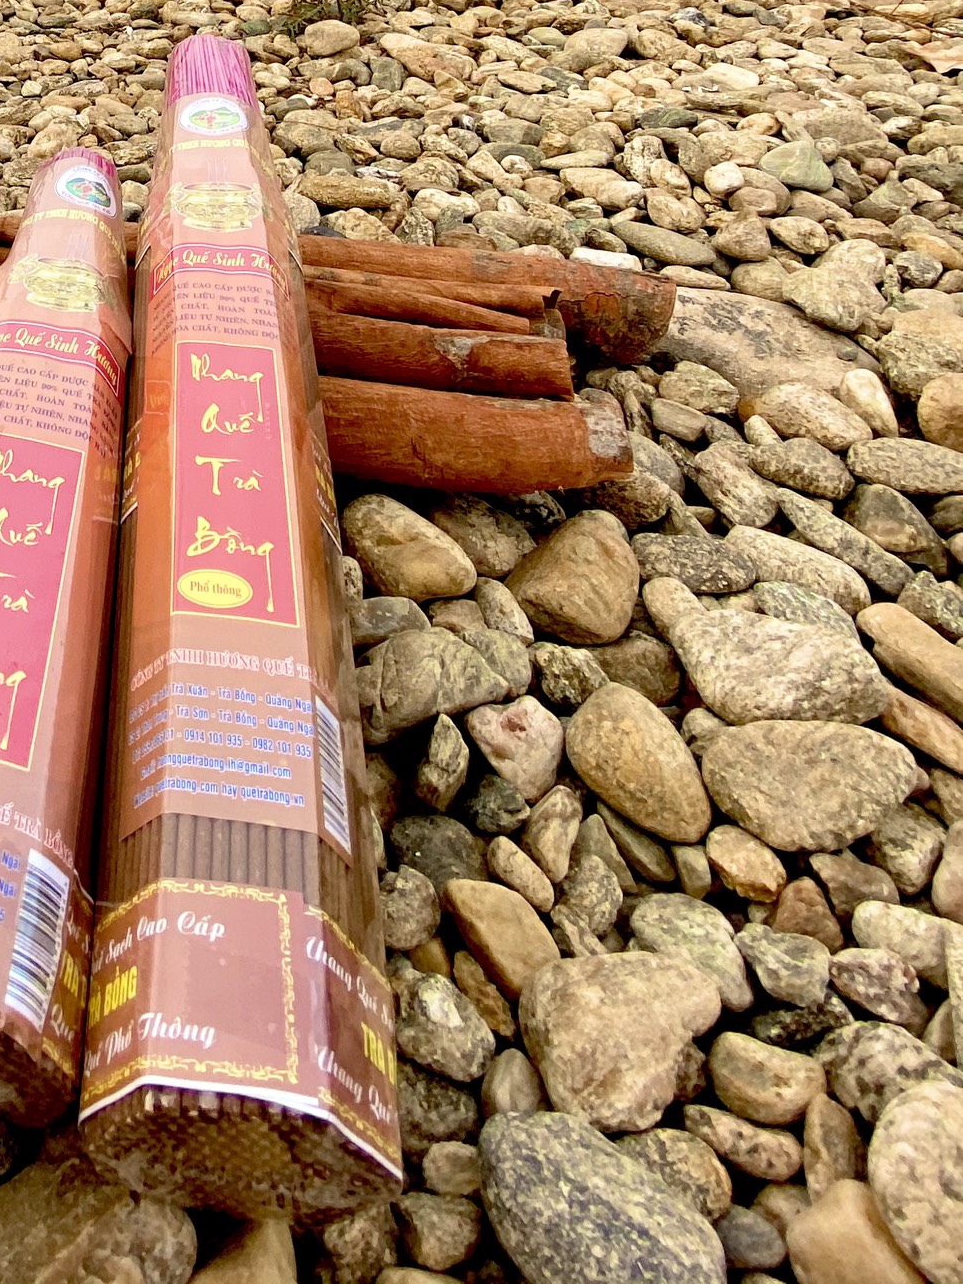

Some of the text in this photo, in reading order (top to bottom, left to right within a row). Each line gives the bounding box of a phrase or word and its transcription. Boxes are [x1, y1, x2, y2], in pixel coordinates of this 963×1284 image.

[182, 249, 210, 265] Quế
[213, 252, 245, 267] Sinh
[14, 328, 45, 348] Quế
[44, 334, 79, 354] Sinh
[84, 340, 117, 385] Hương
[190, 353, 264, 422] Nhang
[201, 403, 254, 436] Quế
[195, 455, 263, 495] Trà
[187, 516, 274, 613] Bồng
[190, 579, 242, 598] Phổ thông
[263, 656, 294, 677] QUẾ
[184, 728, 312, 759] 0914 101 935 0982 101 935
[137, 916, 168, 941] Cao
[177, 911, 225, 942] Cấp
[137, 1012, 217, 1049] Thông
